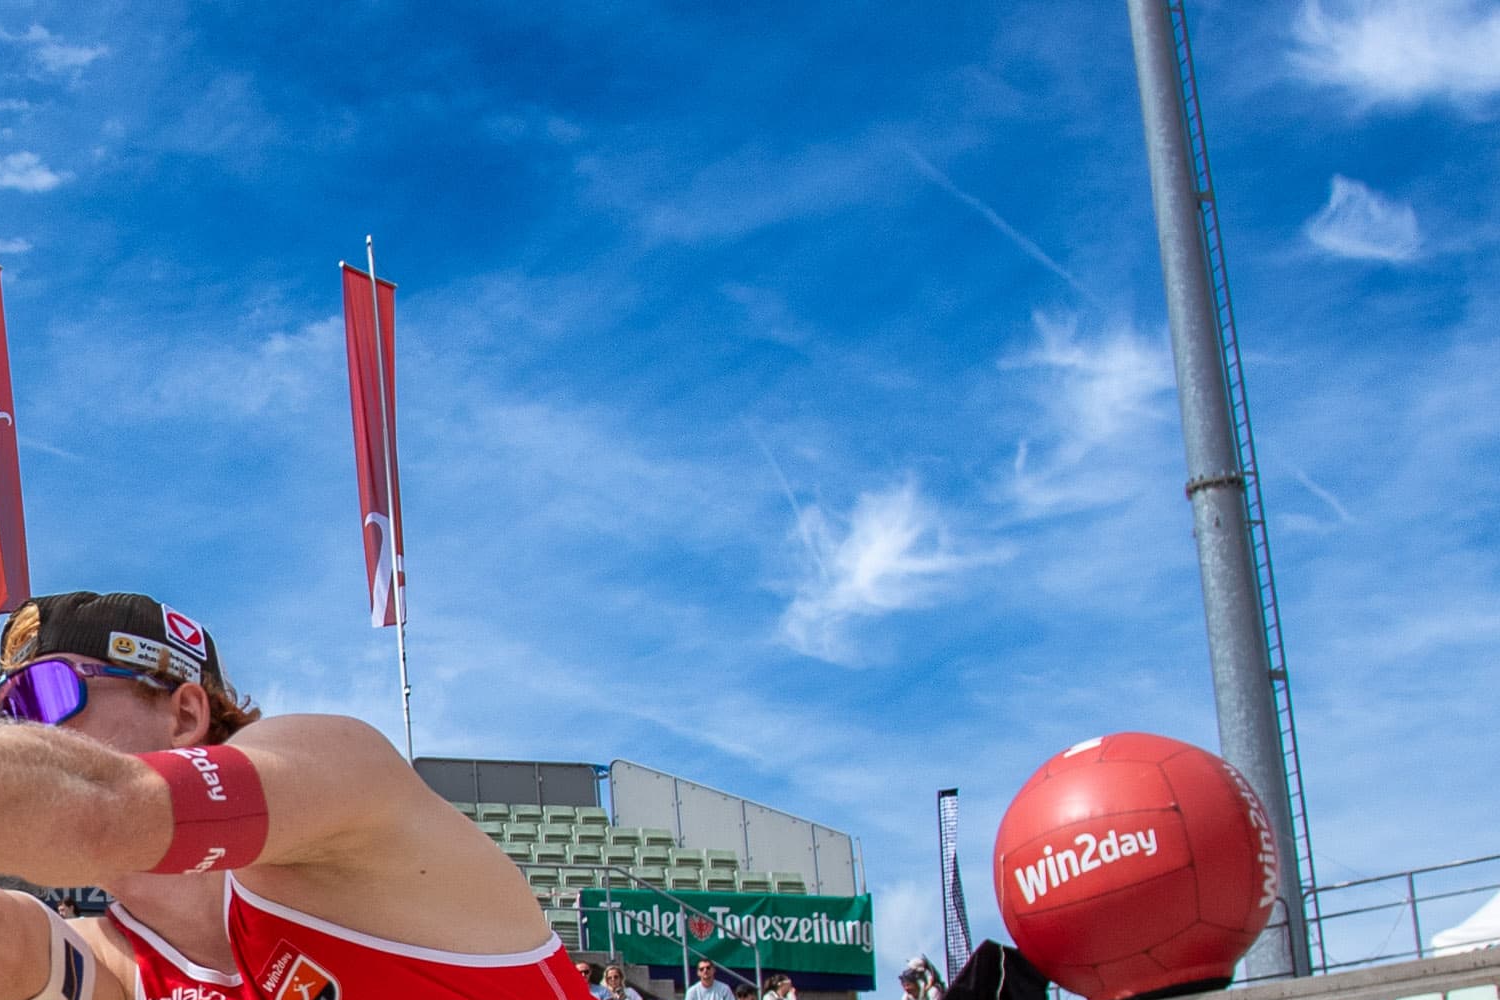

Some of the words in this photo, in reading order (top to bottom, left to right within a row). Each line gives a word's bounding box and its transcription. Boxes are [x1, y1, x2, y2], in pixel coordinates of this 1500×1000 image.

[169, 747, 227, 801] 2day
[1014, 828, 1158, 904] win2day
[599, 900, 687, 938] Tiroler
[708, 906, 873, 952] Tageszeitung
